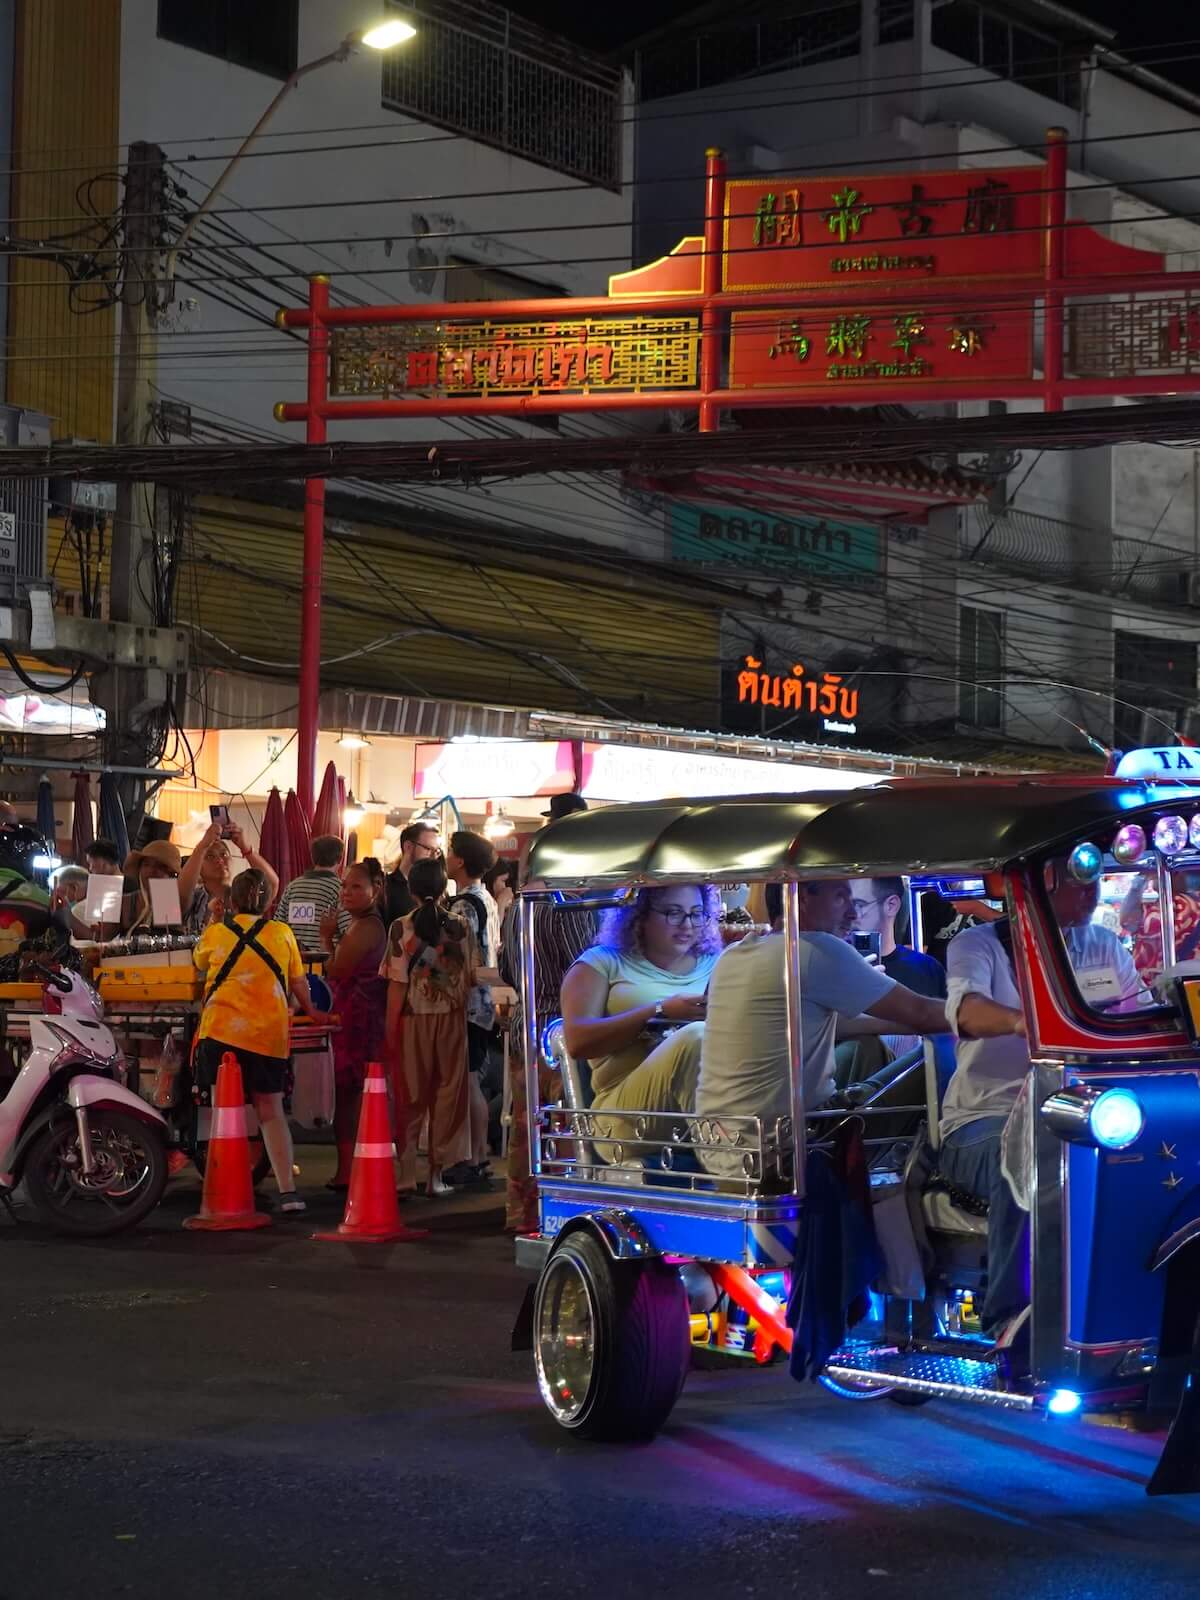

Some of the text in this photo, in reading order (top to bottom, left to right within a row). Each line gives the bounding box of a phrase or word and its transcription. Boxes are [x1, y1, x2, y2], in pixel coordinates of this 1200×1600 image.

[407, 327, 614, 387] ตลาดเก่า
[737, 655, 860, 719] ต้นตำรับ
[544, 1215, 572, 1233] 62
